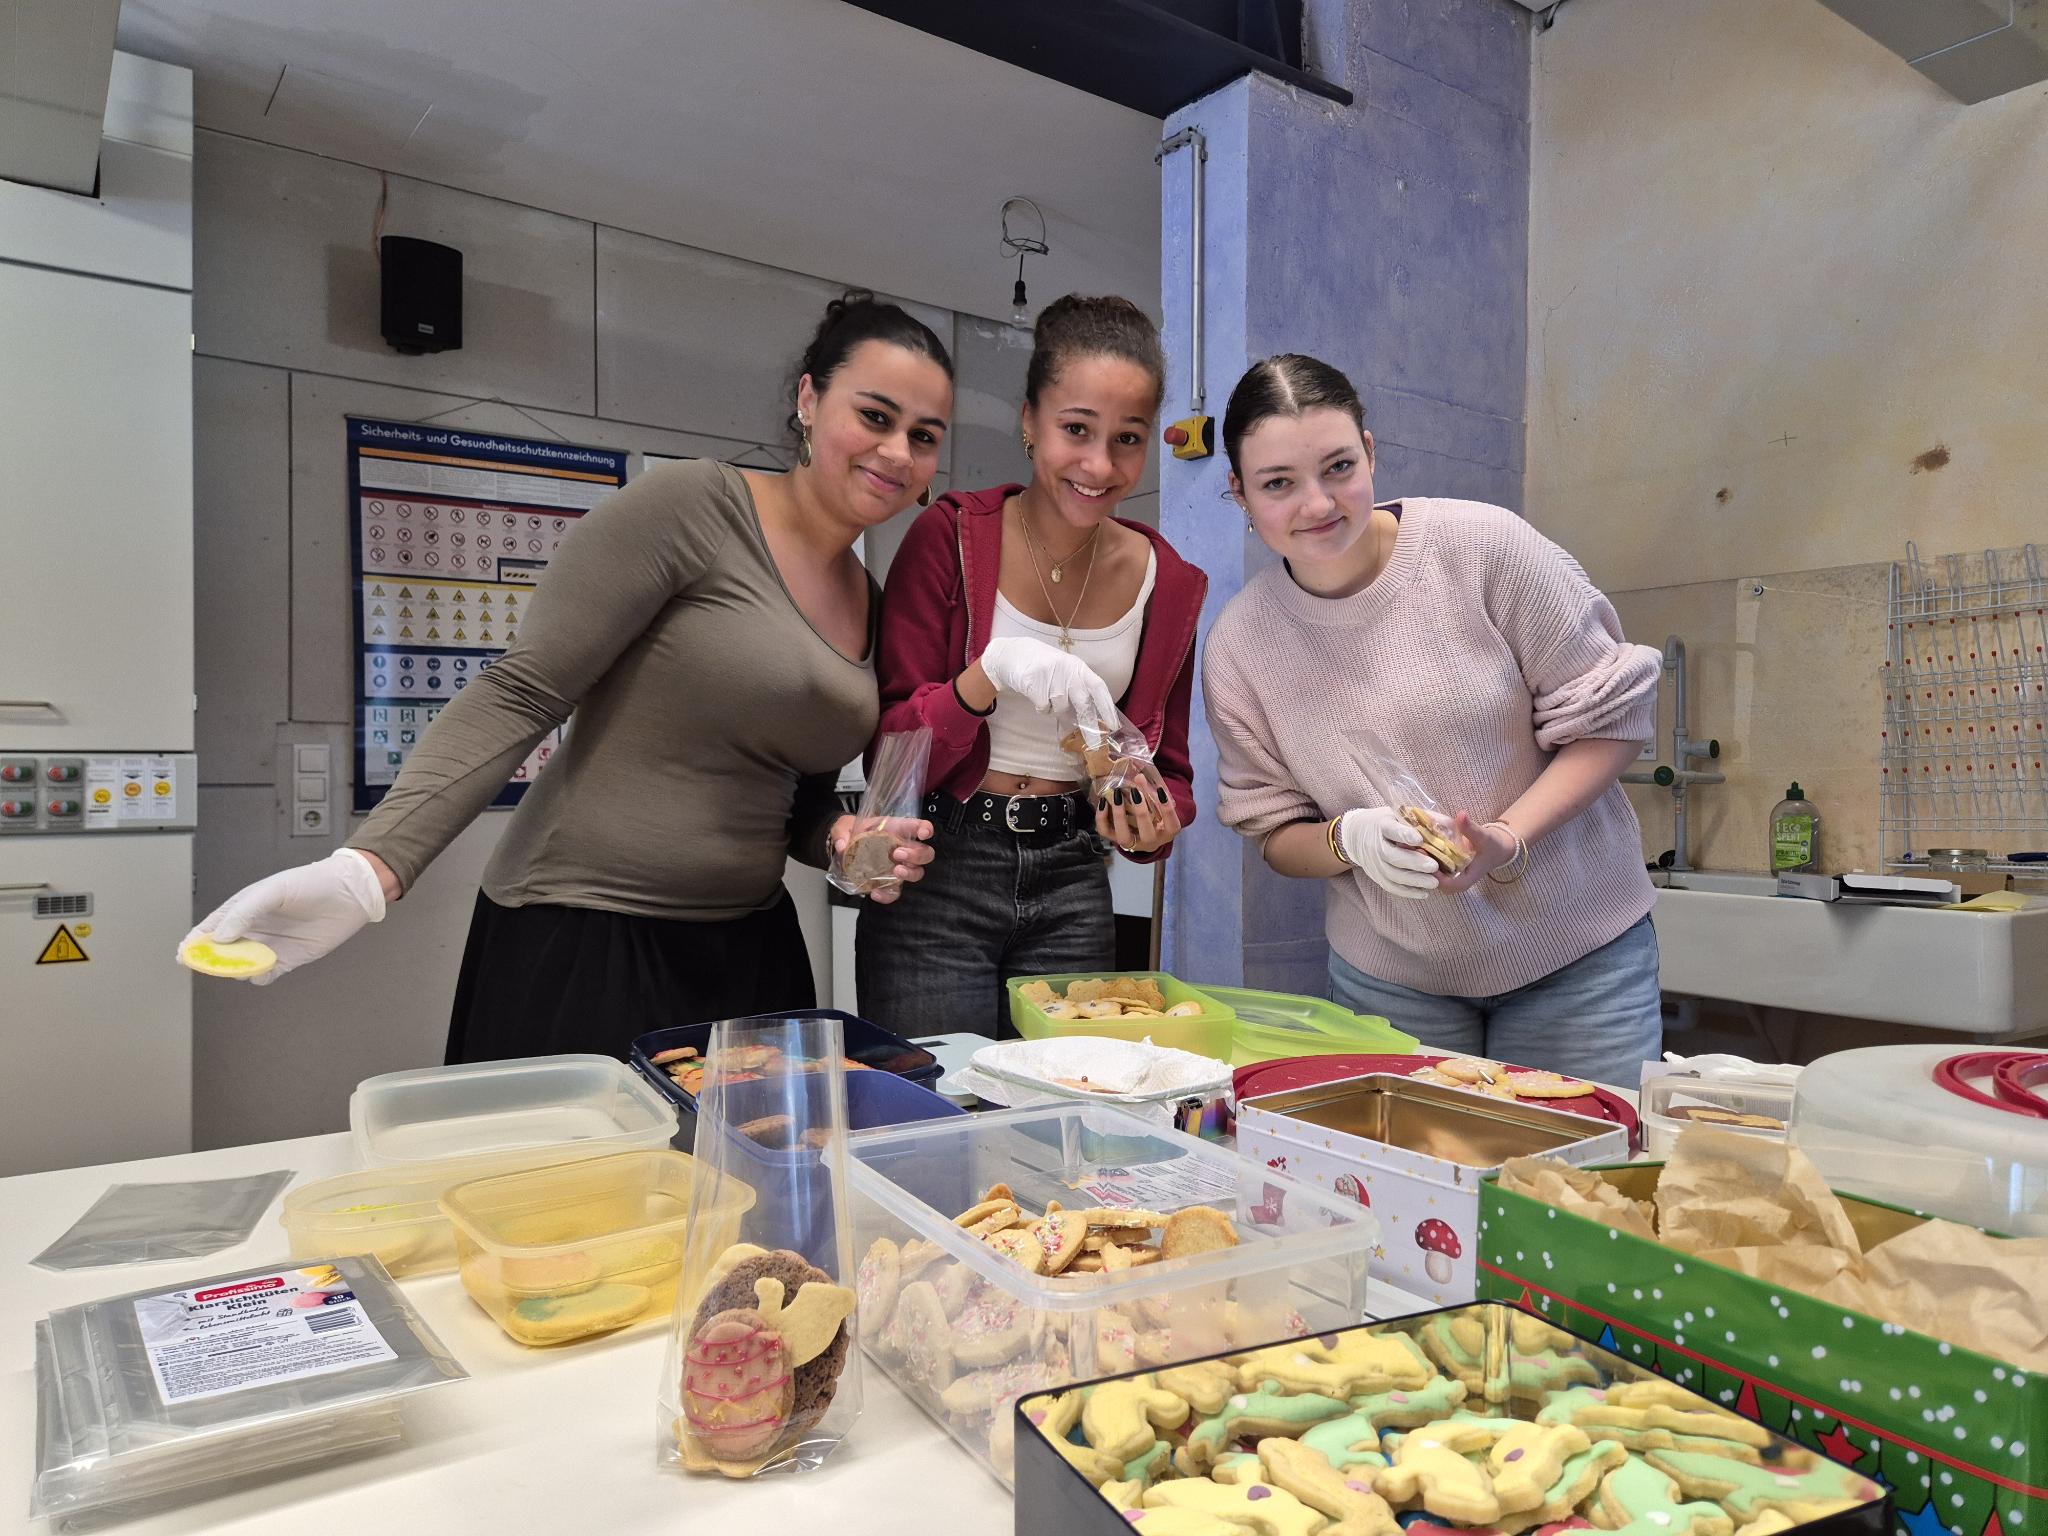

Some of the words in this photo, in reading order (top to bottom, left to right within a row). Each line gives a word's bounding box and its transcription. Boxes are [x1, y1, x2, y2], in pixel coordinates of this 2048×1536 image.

[360, 424, 425, 442] Sicherheits-
[427, 433, 448, 445] und
[450, 434, 616, 468] Gesundheitsschutzkennzeichnung
[188, 1287, 299, 1312] Klarsichttüten
[202, 1282, 278, 1301] Profissimo
[328, 1296, 352, 1304] Stück
[226, 1298, 268, 1311] Klein
[197, 1316, 214, 1325] mit
[217, 1306, 269, 1320] Standboden
